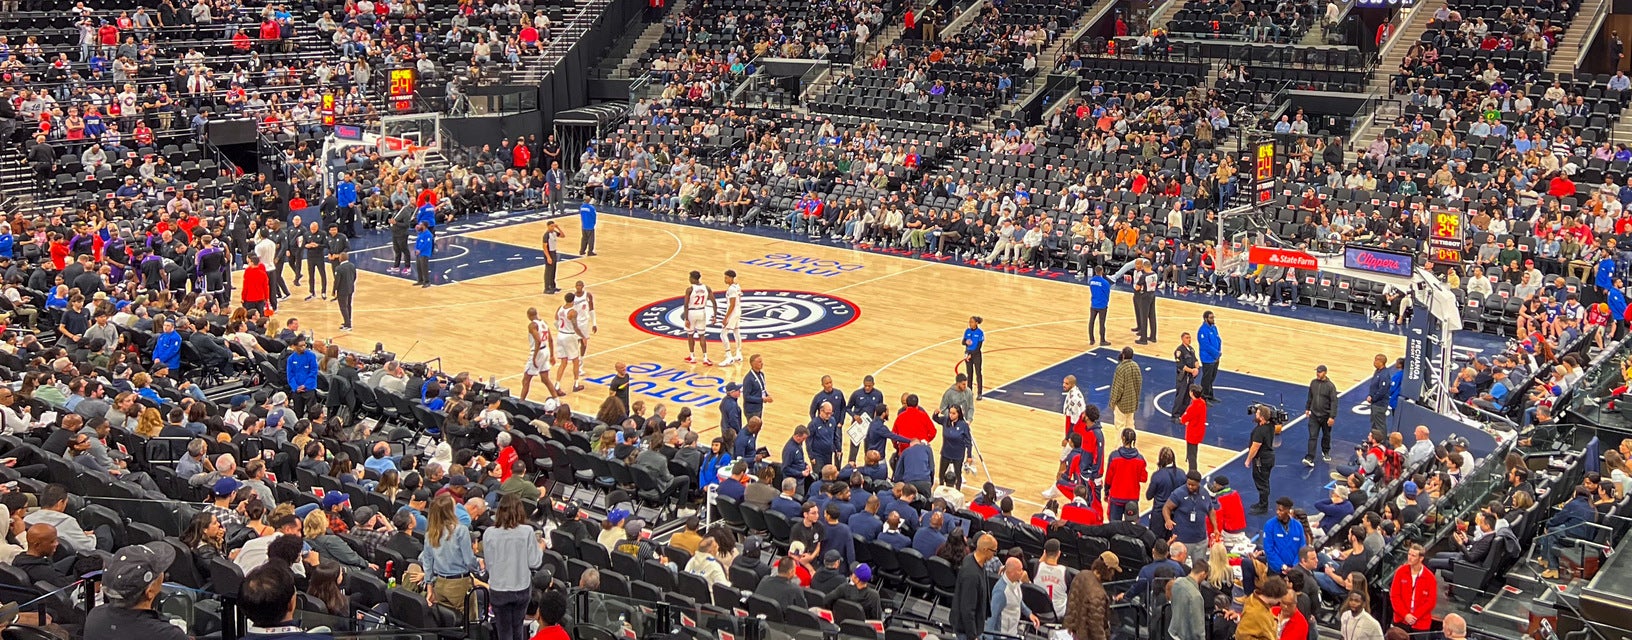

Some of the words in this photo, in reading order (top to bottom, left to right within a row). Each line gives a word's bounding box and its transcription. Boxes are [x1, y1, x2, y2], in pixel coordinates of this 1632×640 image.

[391, 79, 410, 94] 24
[1257, 156, 1272, 180] 24
[1438, 223, 1455, 236] 24
[1280, 254, 1298, 264] State
[1297, 256, 1315, 266] Farm
[1356, 251, 1400, 270] Clippers
[694, 295, 705, 305] 21
[1413, 339, 1421, 380] PECHANGA
[583, 373, 722, 408] INTUT
[1046, 584, 1053, 600] 1
